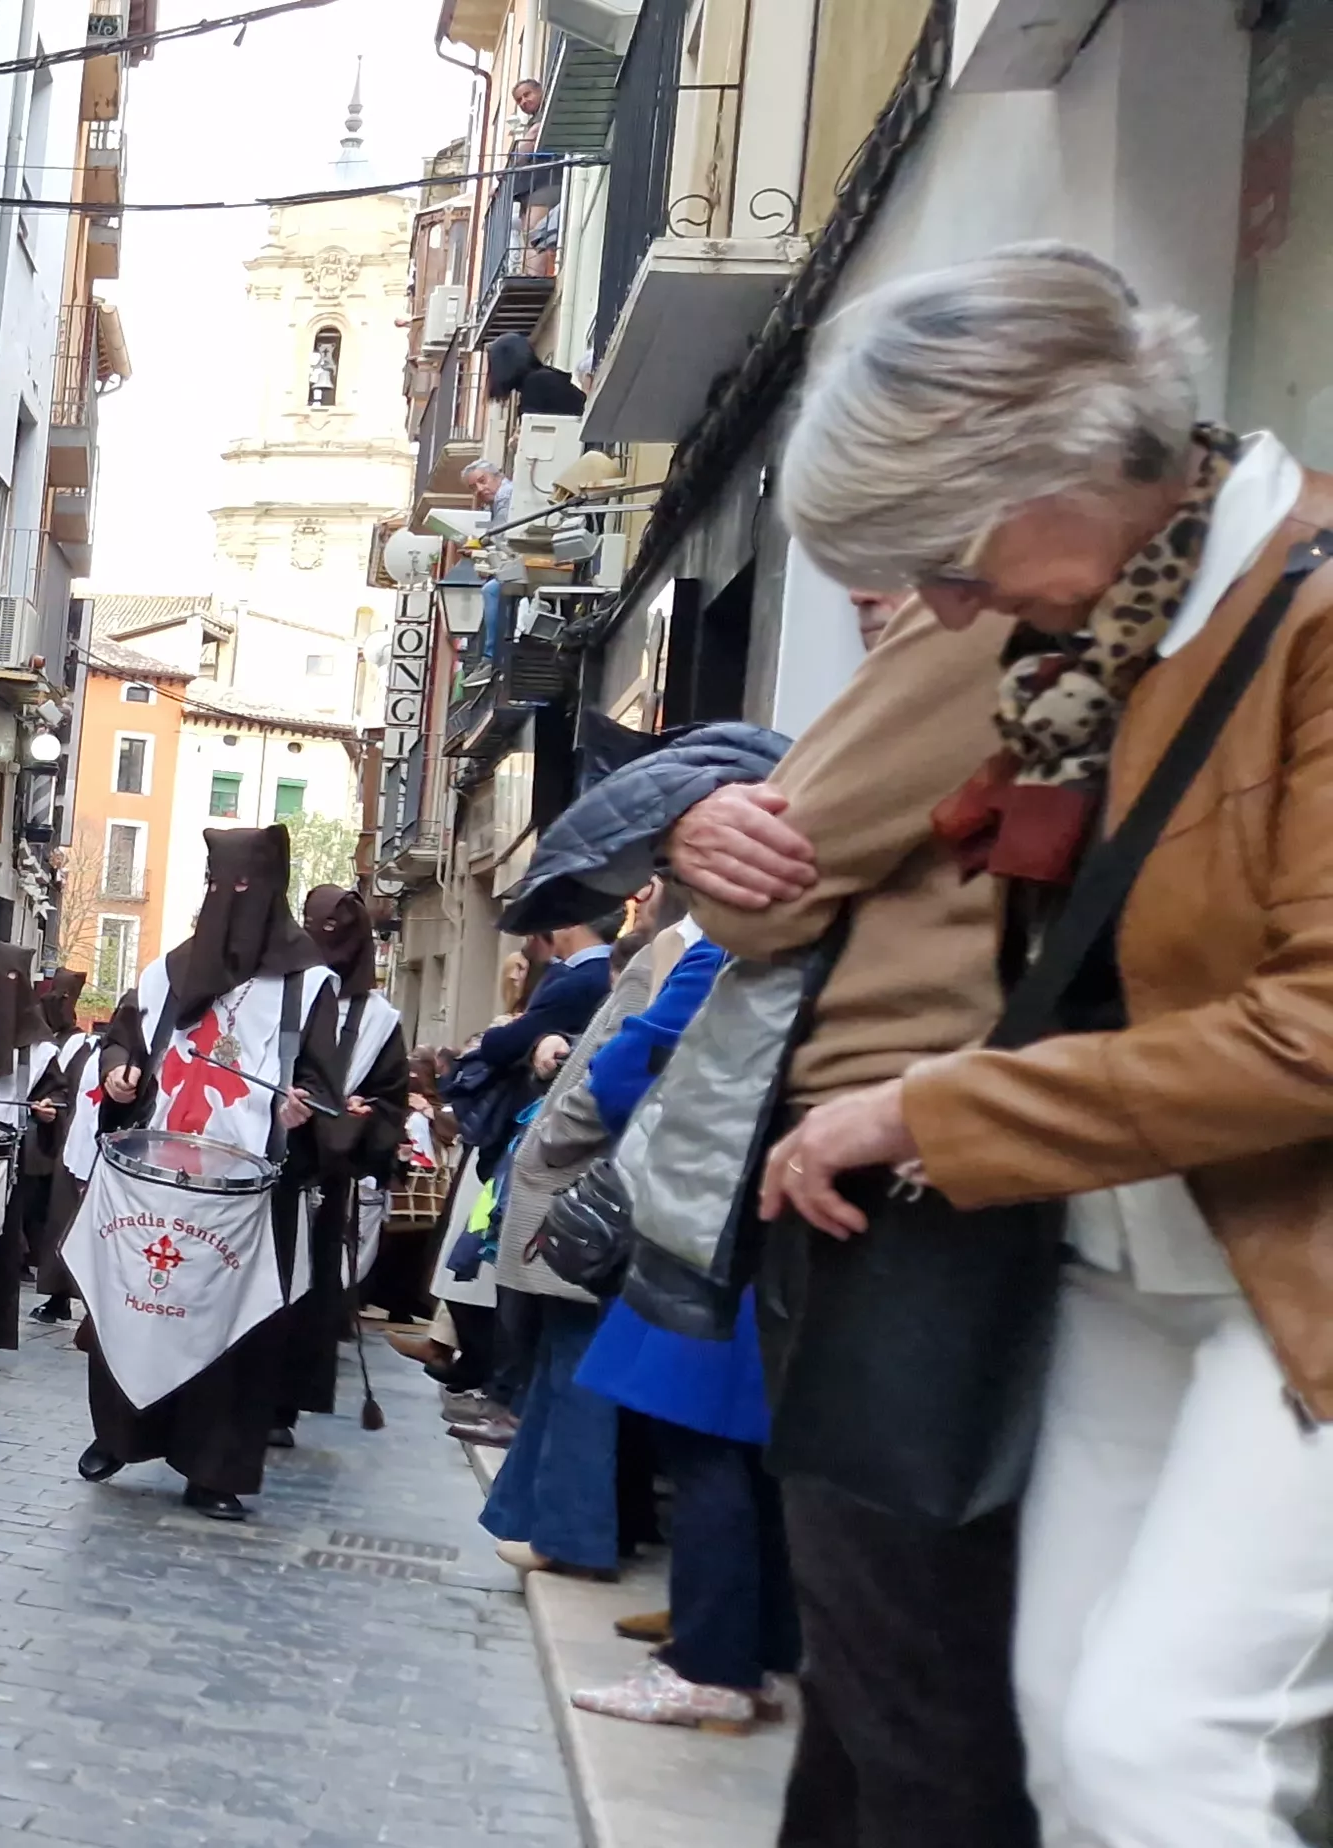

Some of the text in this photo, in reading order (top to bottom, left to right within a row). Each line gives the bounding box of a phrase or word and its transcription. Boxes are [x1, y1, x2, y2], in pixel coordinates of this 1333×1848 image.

[99, 1212, 242, 1271] Cofradia Santiago
[124, 1293, 187, 1318] Huesca
